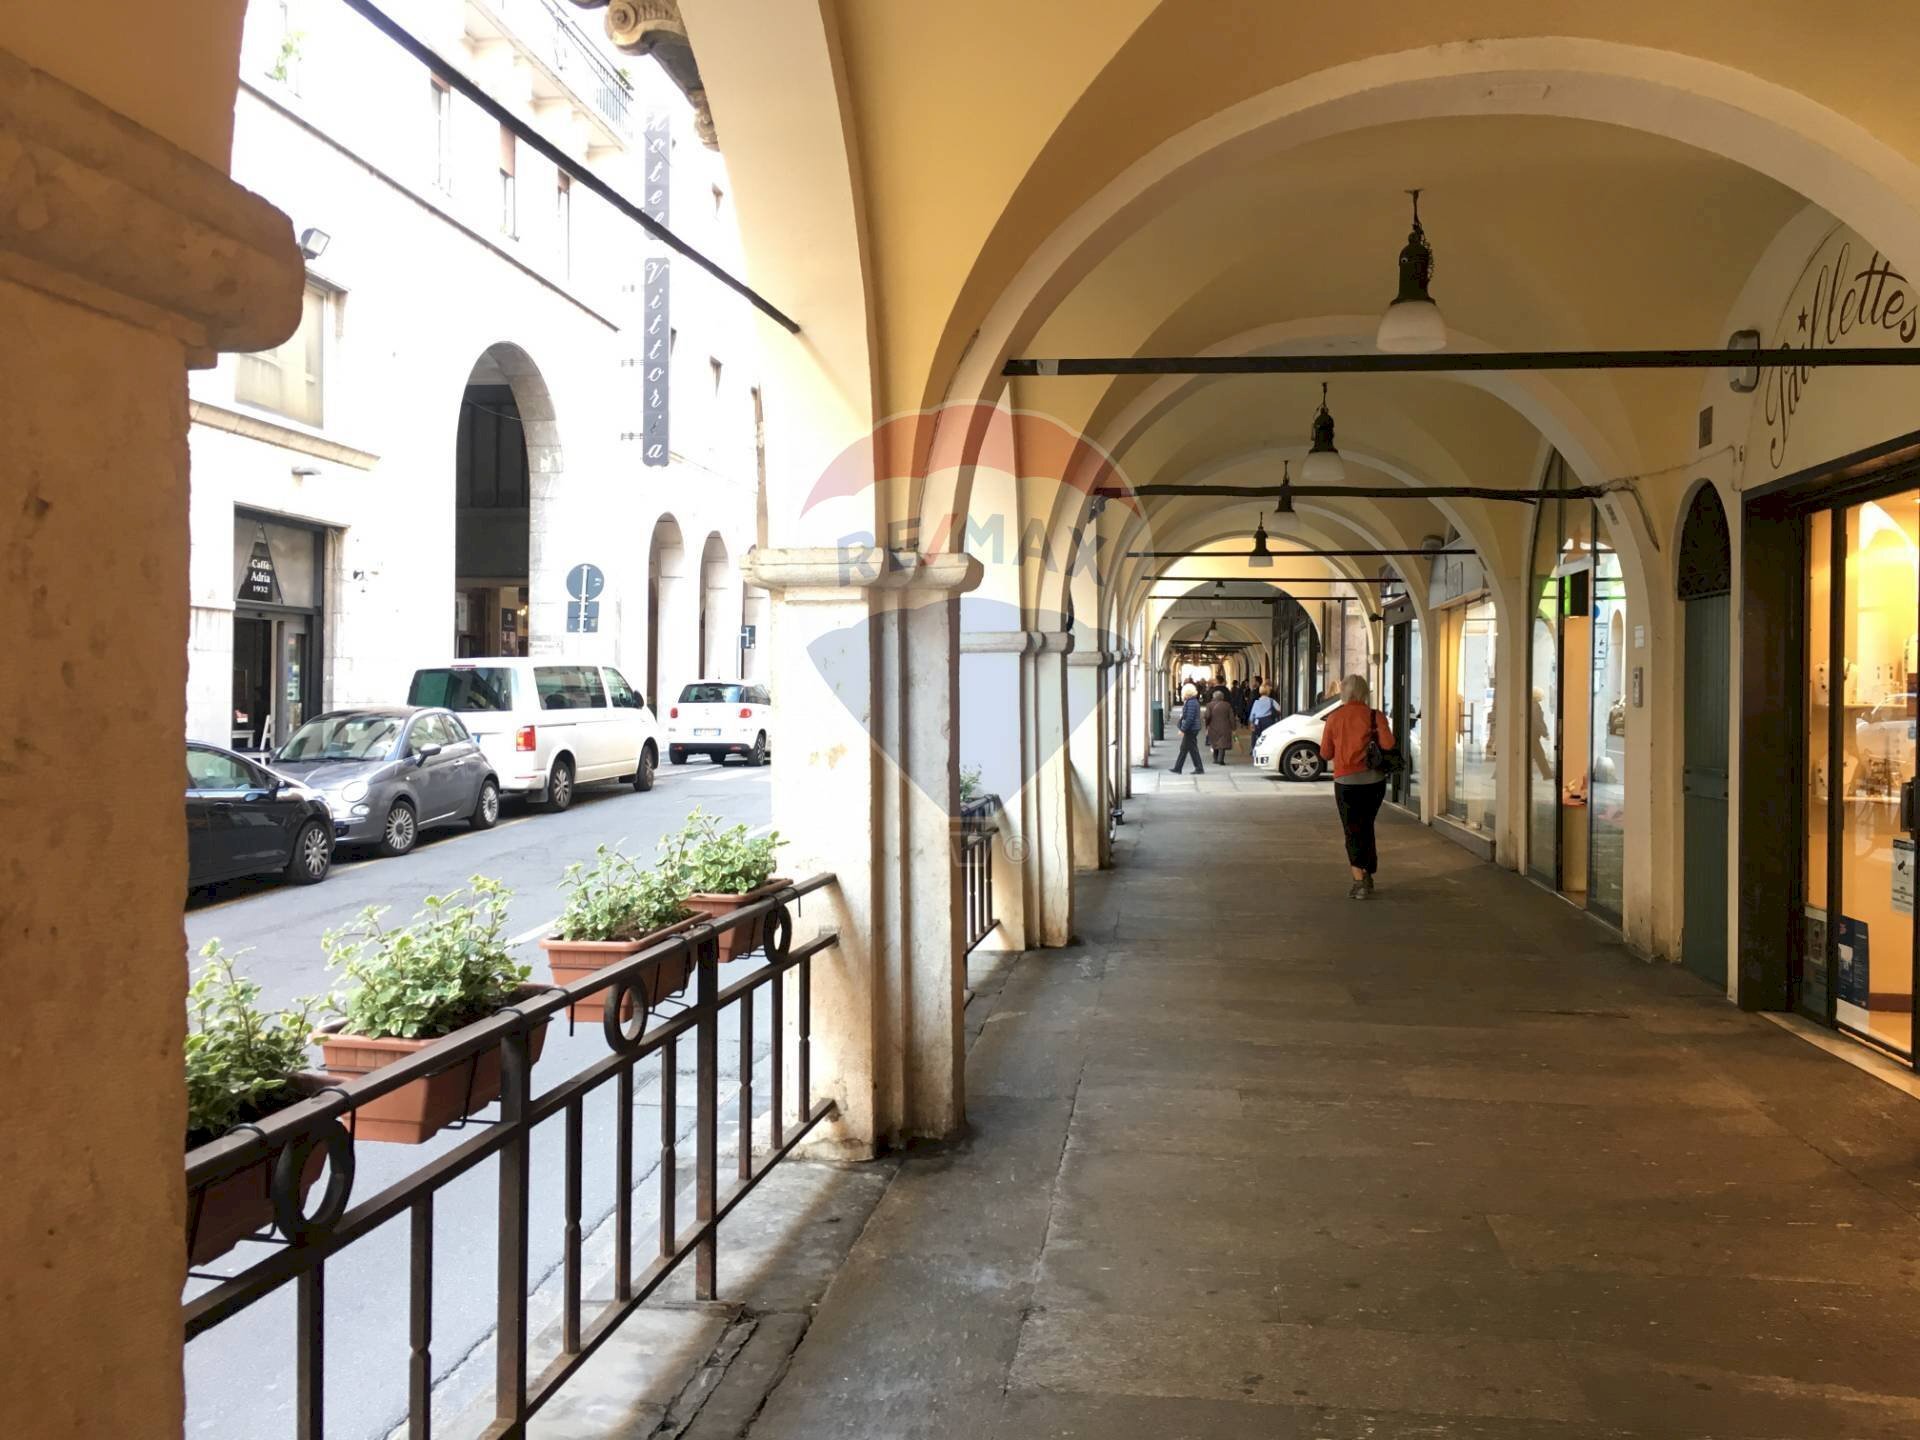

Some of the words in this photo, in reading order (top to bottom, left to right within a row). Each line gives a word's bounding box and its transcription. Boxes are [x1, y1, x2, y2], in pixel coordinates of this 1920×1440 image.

[647, 261, 669, 459] Vittoria
[250, 571, 271, 583] Adria
[252, 584, 269, 593] 1932
